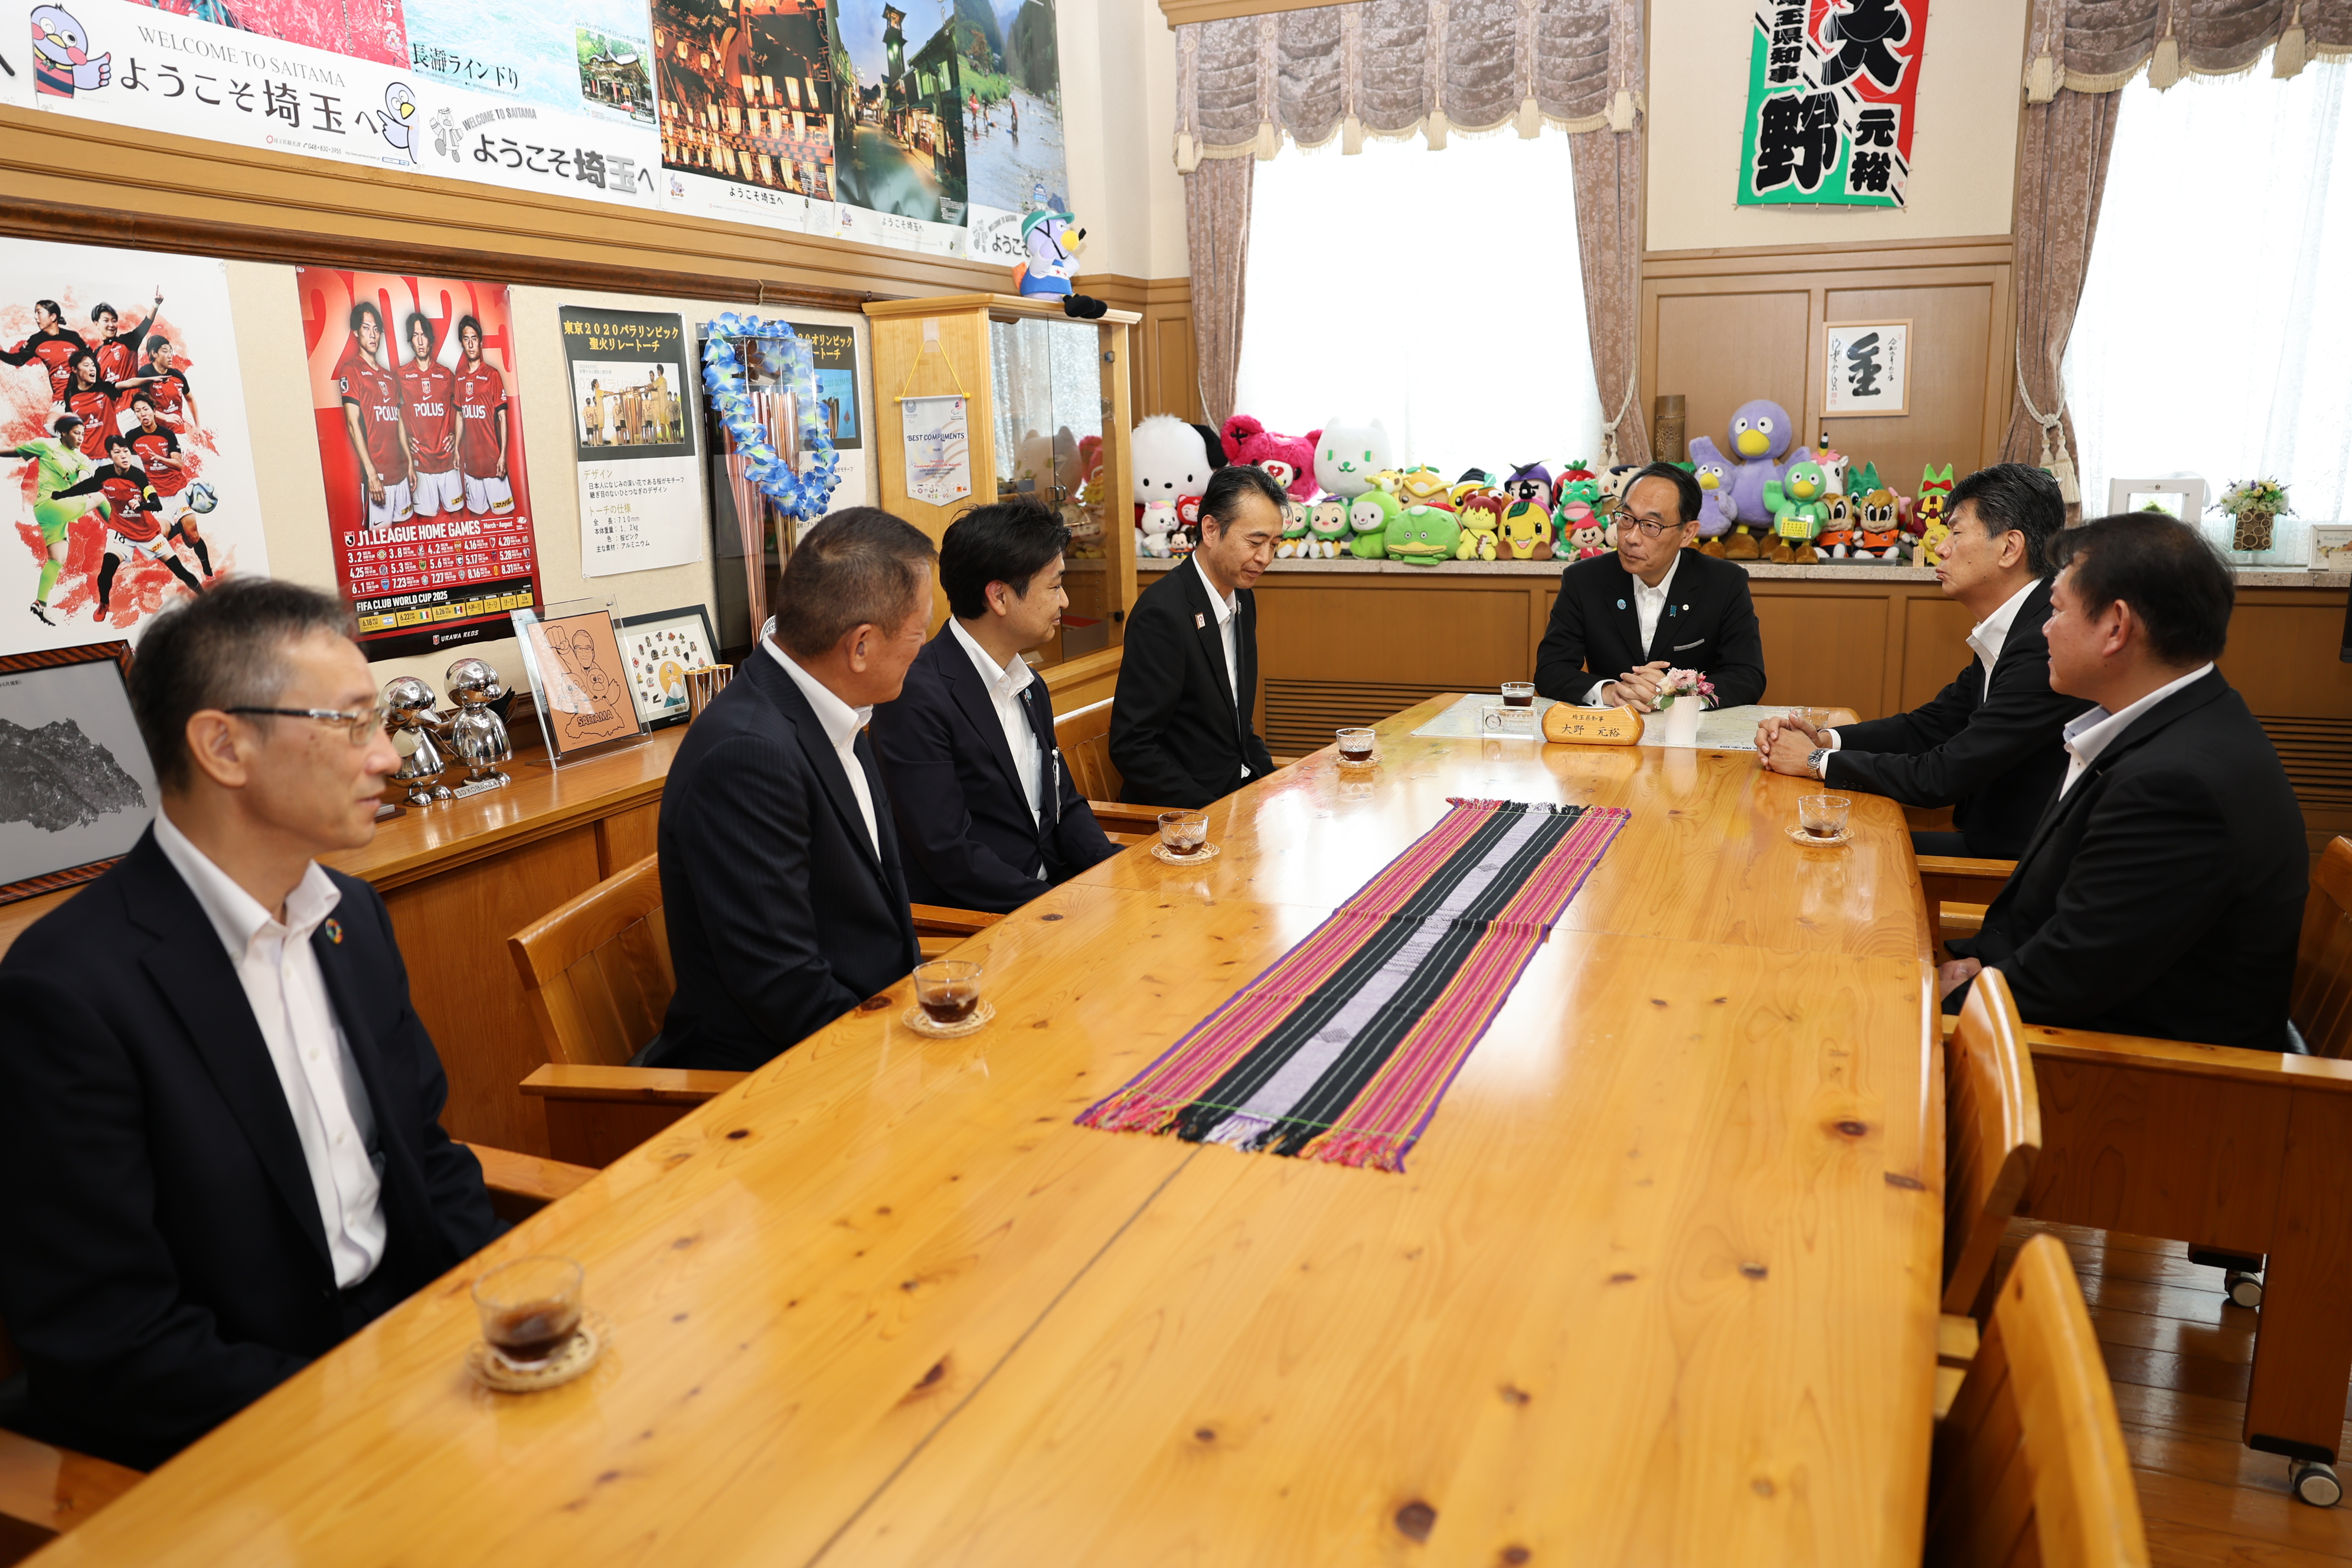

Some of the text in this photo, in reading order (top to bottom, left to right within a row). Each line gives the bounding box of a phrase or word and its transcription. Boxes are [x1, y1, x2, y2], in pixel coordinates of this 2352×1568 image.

[138, 26, 345, 87] WELCOME TO SAITAMA
[411, 43, 518, 90] 長瀞ライン下り
[120, 57, 378, 135] ようこそ埼玉へ
[462, 107, 537, 131] WELCOME TO SAITAMA
[274, 138, 301, 147] 埼玉県観光課
[1850, 109, 1895, 192] 元裕
[473, 133, 655, 194] ようこそ埼玉へ
[730, 186, 783, 205] ようこそ埼玉へ
[882, 217, 924, 232] ようこそ埼玉へ
[563, 320, 679, 339] 東京2020パラリンピック
[589, 337, 660, 352] 聖火リレートーチ
[413, 403, 444, 417] POLUS
[924, 433, 965, 442] COMPLIMENTS
[584, 469, 612, 481] デザイン
[589, 477, 684, 490] 日本人になじみの深い花である桜がモチーフ
[589, 486, 667, 499] 継ぎ目のないひとつなぎのデザイン
[589, 502, 632, 516] トーチの仕様
[499, 521, 512, 529] August
[357, 520, 481, 547] J1.LEAGUE HOME GAMES
[464, 540, 477, 550] 4.16
[498, 536, 511, 547] 4.20
[389, 547, 403, 558] 3.8
[428, 544, 440, 554] 4.2
[348, 551, 362, 563] 3.2
[466, 554, 478, 564] 5.17
[499, 550, 512, 561] 5.28
[391, 562, 404, 574] 5.3
[430, 558, 442, 569] 5.6
[501, 564, 514, 574] 8.31
[350, 567, 364, 579] 4.25
[431, 572, 444, 584] 7.27
[468, 568, 481, 579] 8.16
[352, 582, 365, 594] 6.1
[392, 577, 407, 589] 7.23
[357, 591, 447, 612] FIFA CLUB WORLD CUP 2025
[441, 632, 461, 642] URAWA
[577, 710, 613, 727] SAITAMA
[1572, 714, 1604, 723] 埼玉県知事
[1562, 723, 1621, 737] 大野 元裕
[467, 780, 498, 793] KOBATON
